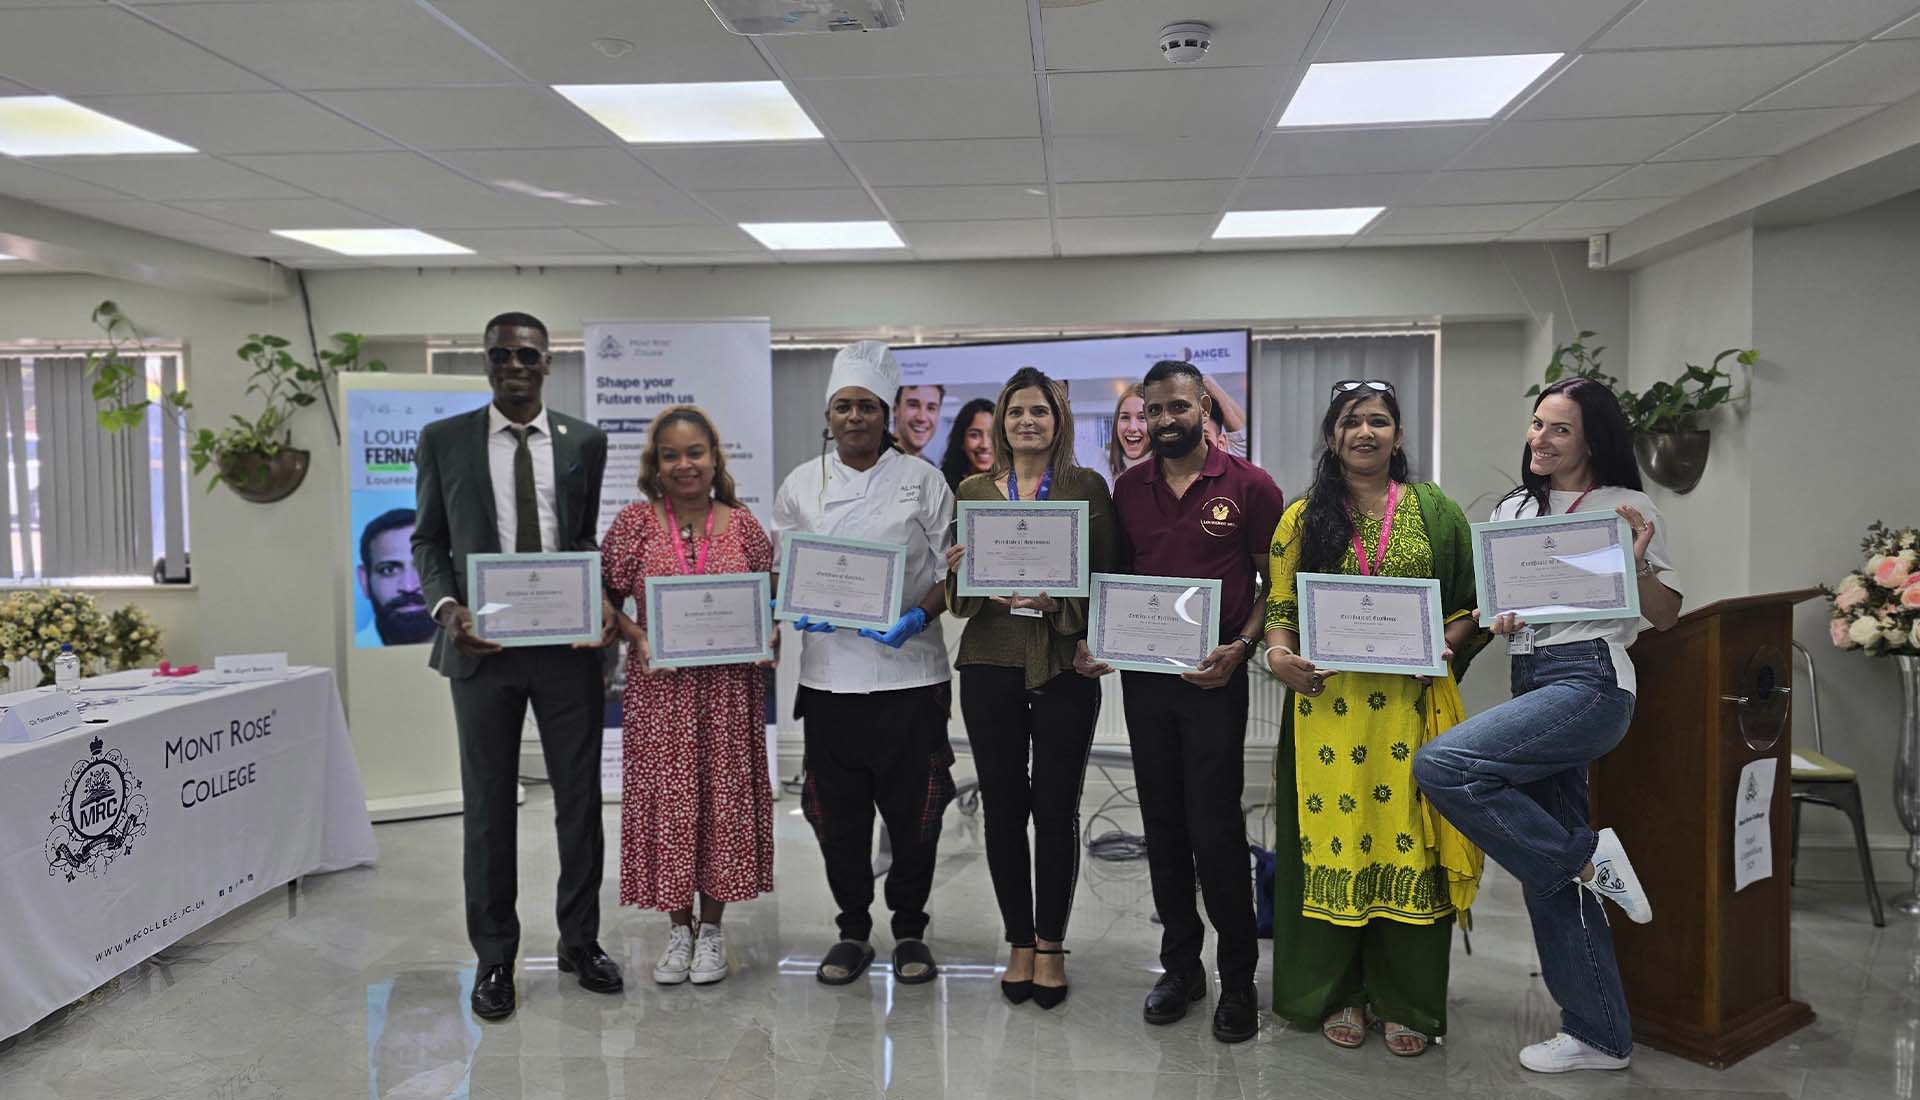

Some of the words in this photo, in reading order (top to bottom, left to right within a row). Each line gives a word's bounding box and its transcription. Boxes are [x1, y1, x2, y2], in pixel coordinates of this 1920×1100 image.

[1193, 347, 1231, 359] ANGEL
[596, 376, 640, 390] Shape
[643, 377, 674, 390] your
[596, 393, 642, 405] Future
[645, 391, 674, 404] with
[678, 394, 695, 404] us
[165, 729, 225, 769] MONT
[181, 762, 256, 808] COLLEGE
[80, 797, 118, 830] MRC
